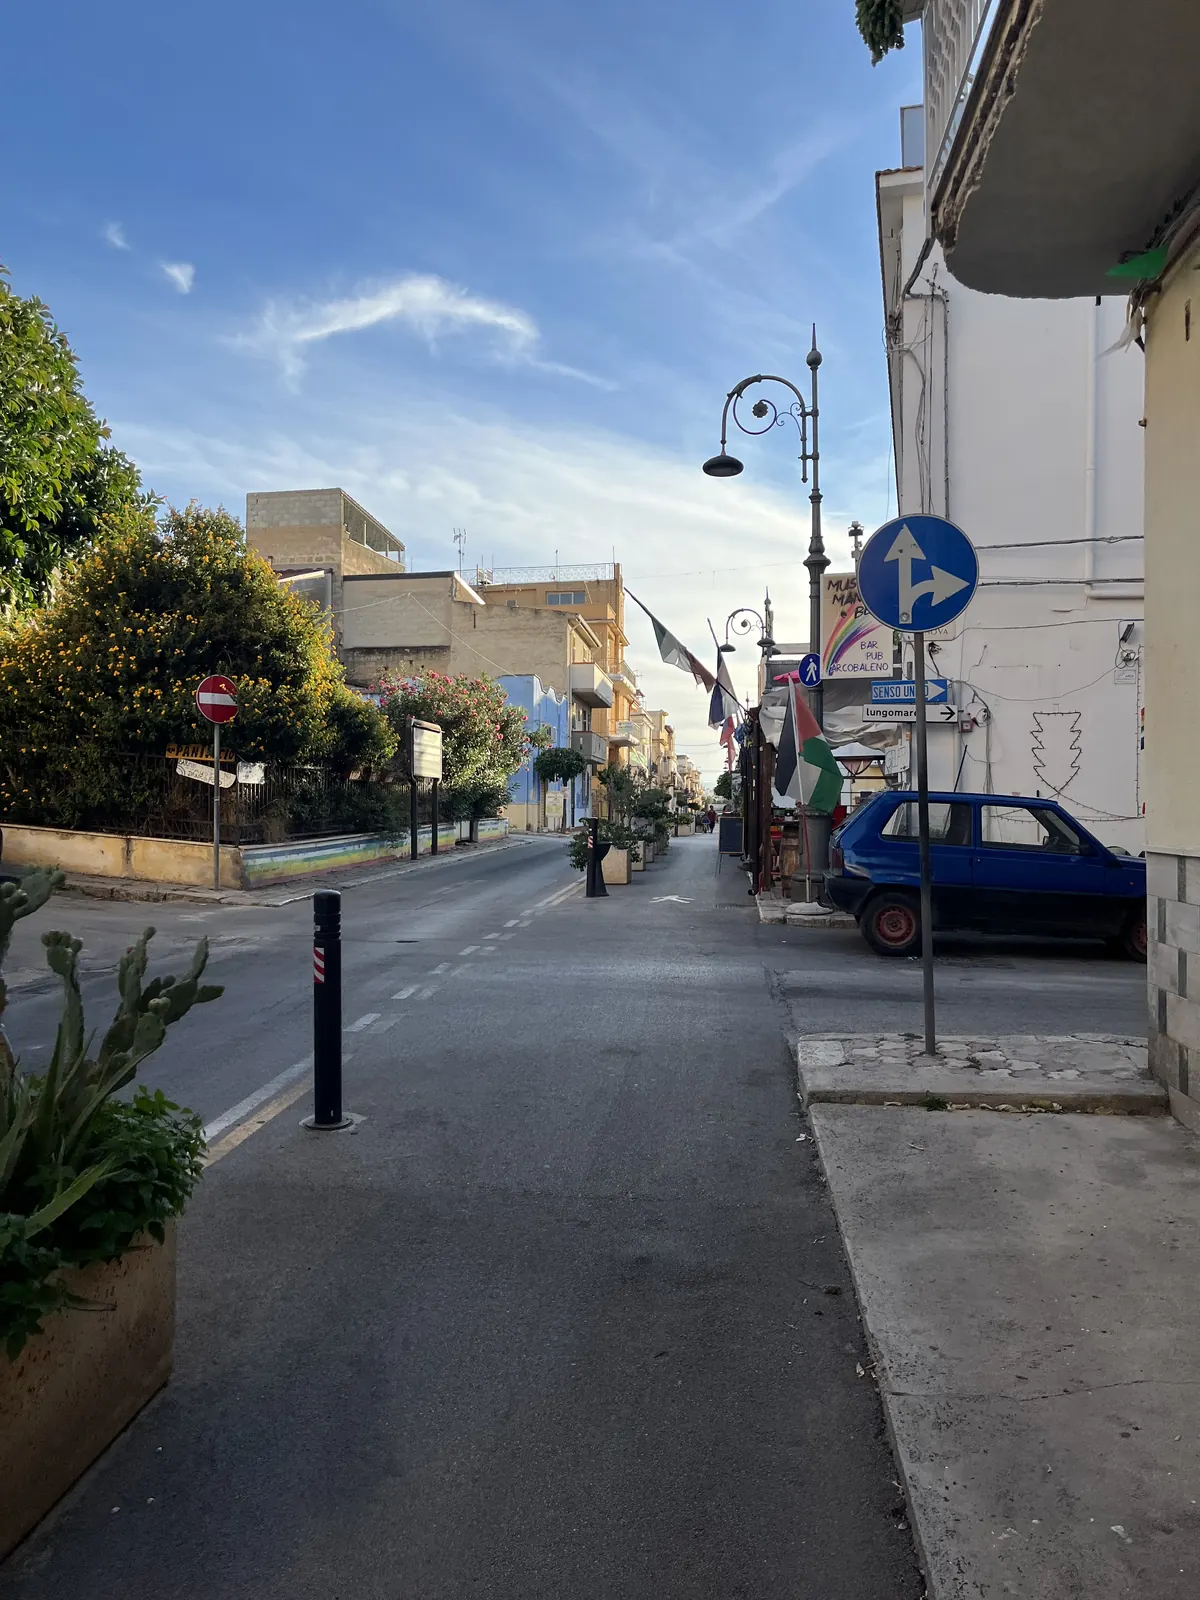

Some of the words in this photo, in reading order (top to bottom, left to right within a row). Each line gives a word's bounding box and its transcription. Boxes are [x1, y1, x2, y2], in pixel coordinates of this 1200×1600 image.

[828, 577, 857, 592] MUS
[832, 592, 862, 606] MAN
[860, 640, 878, 650] BAR
[866, 651, 883, 660] PUB
[831, 662, 889, 672] ARCOBALENO
[873, 686, 900, 698] SENSO
[904, 685, 929, 697] UNO
